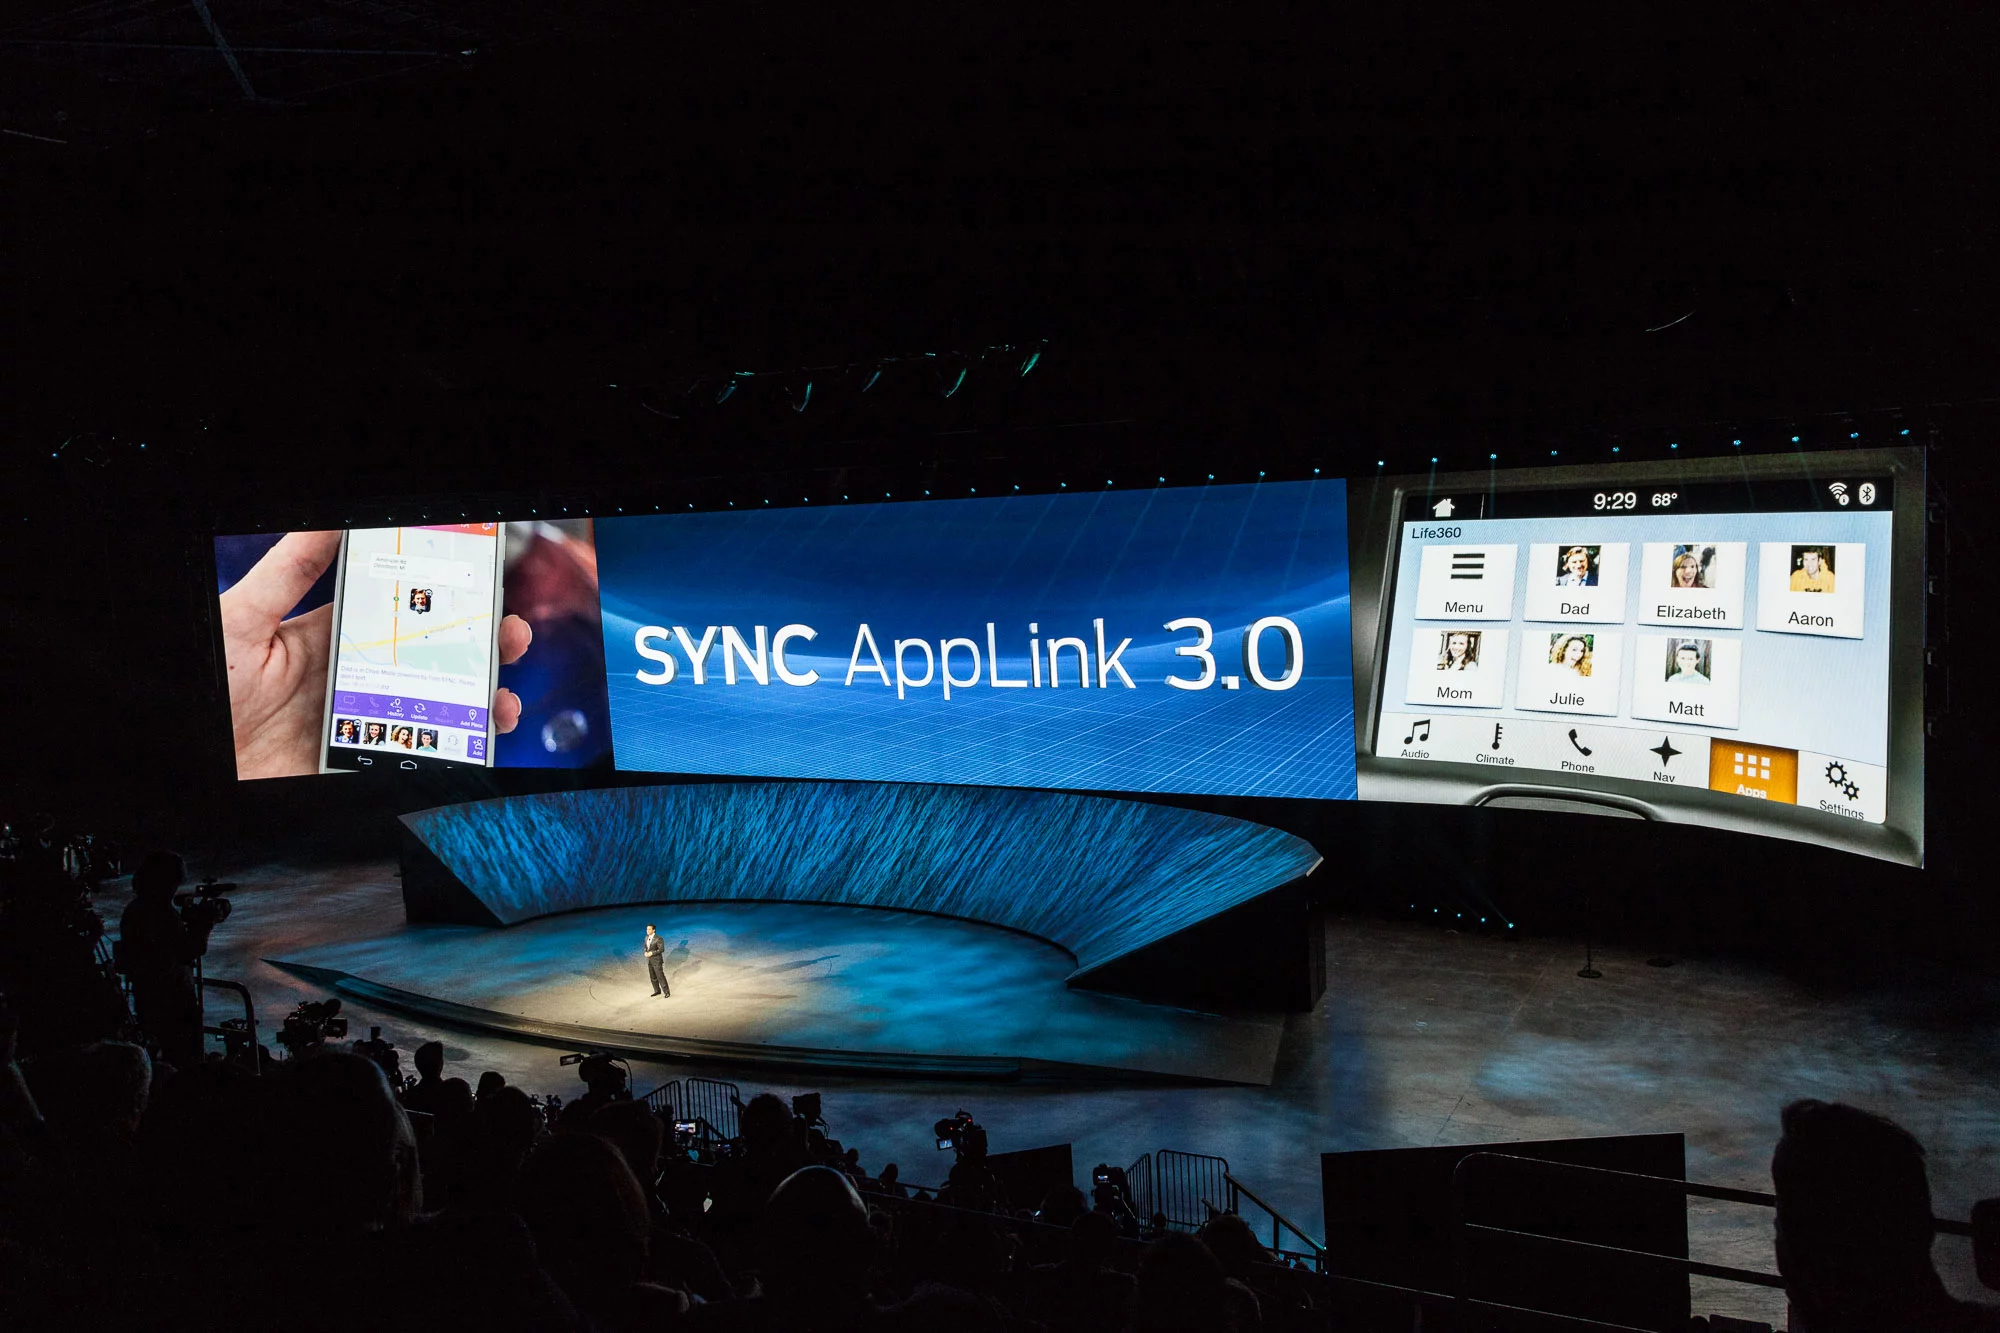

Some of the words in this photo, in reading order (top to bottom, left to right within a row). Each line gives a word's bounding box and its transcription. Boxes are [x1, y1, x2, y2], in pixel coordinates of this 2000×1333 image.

[1594, 492, 1637, 510] 9:29
[1652, 493, 1678, 507] 68°
[1411, 526, 1462, 539] Life360
[1444, 601, 1484, 614] Menu
[1560, 602, 1590, 615] Dad
[1656, 605, 1726, 621] Elizabeth
[1788, 611, 1834, 627] Aaron
[635, 623, 819, 687] SYNC
[845, 618, 1137, 700] AppLink
[1163, 617, 1304, 692] 3.0
[1436, 686, 1473, 699] Mom
[1550, 692, 1585, 706] Julie
[387, 710, 405, 718] History
[1669, 701, 1705, 717] Matt
[410, 713, 428, 721] Update
[1401, 748, 1430, 759] Audio
[1475, 753, 1515, 765] Climate
[1561, 760, 1595, 773] Phone
[1653, 771, 1676, 783] Nav
[1736, 783, 1767, 799] Apps
[1819, 799, 1865, 820] Settings
